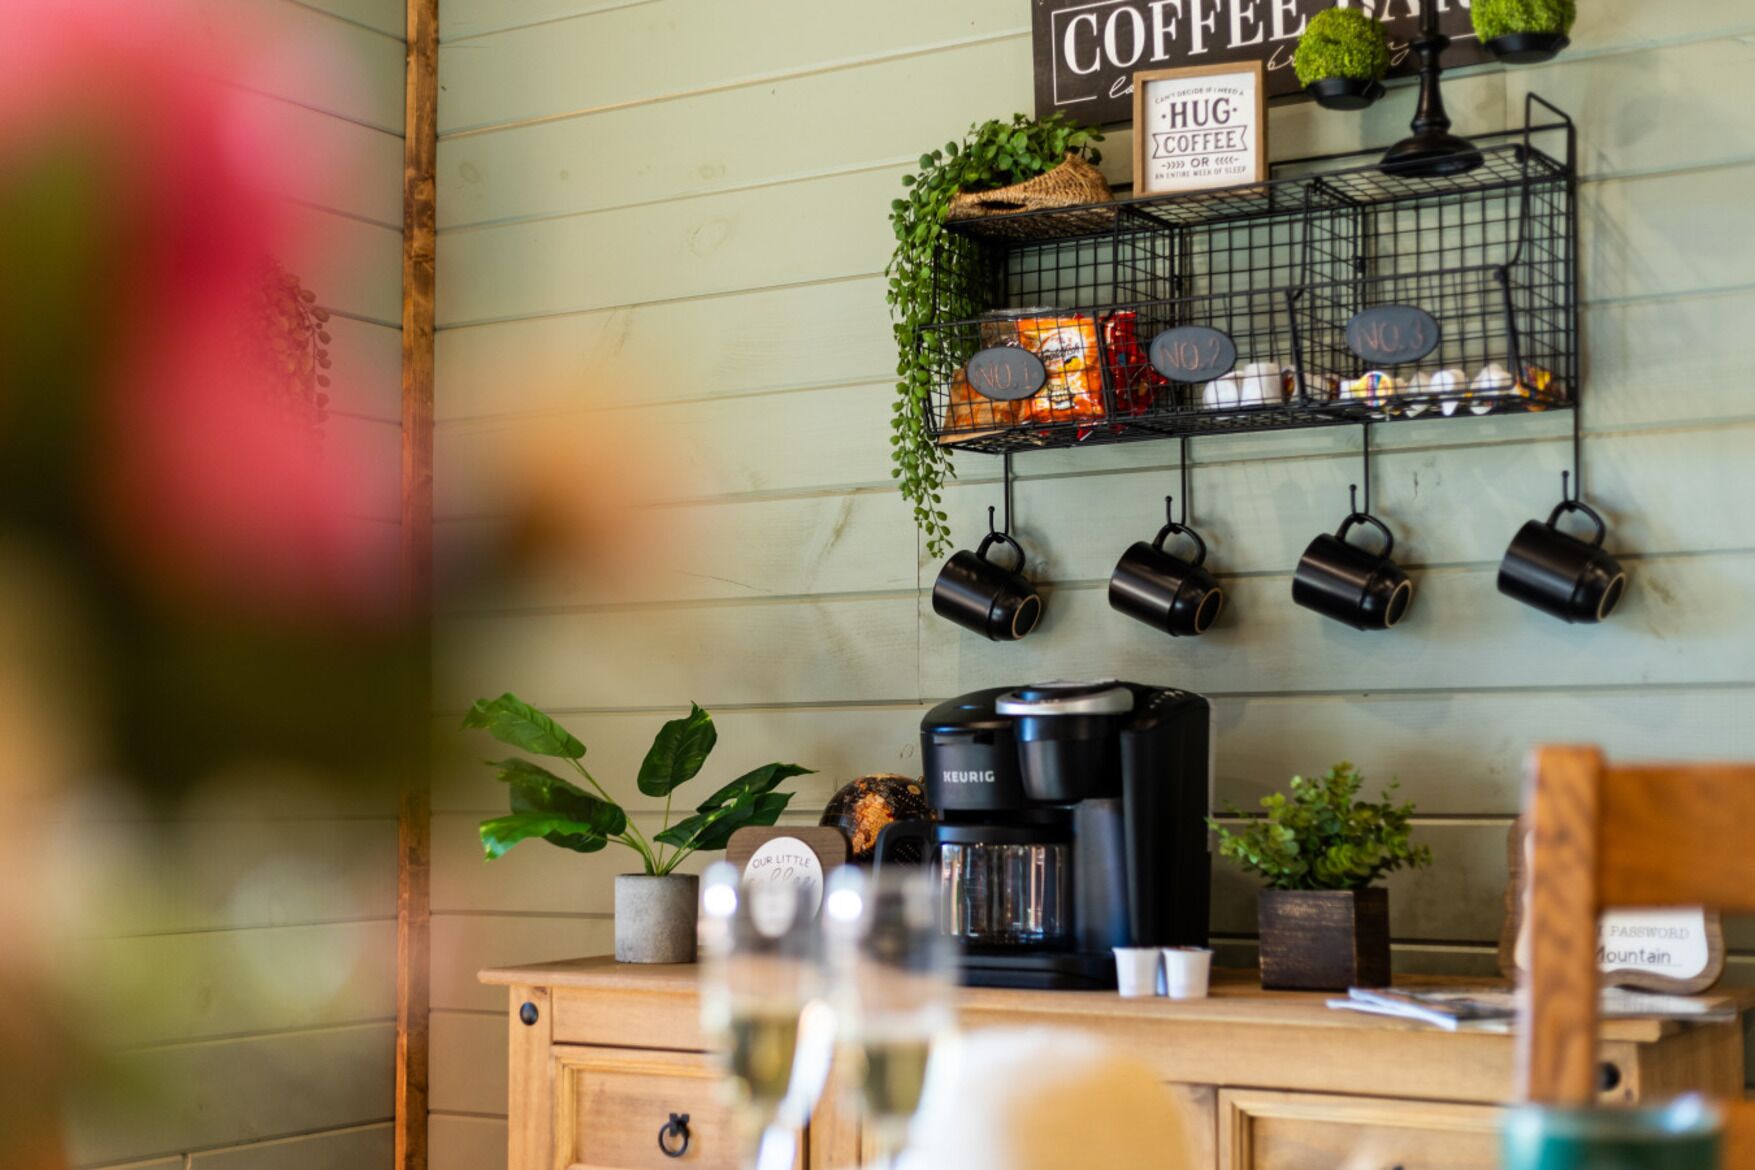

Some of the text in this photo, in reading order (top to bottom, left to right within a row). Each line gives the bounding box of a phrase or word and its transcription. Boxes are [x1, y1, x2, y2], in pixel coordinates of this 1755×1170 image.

[1064, 0, 1306, 75] COFFEE
[1177, 87, 1204, 97] DECIDE
[1217, 87, 1238, 95] NEED
[1169, 97, 1231, 129] HUG
[1163, 130, 1237, 154] COFFEE
[1190, 157, 1209, 168] OR
[1155, 165, 1246, 180] AN ENTIRE WEEK OF SLEEP
[943, 770, 996, 783] KEURIG
[752, 854, 811, 869] OUR LITTLE
[1609, 925, 1690, 940] PASSWORD
